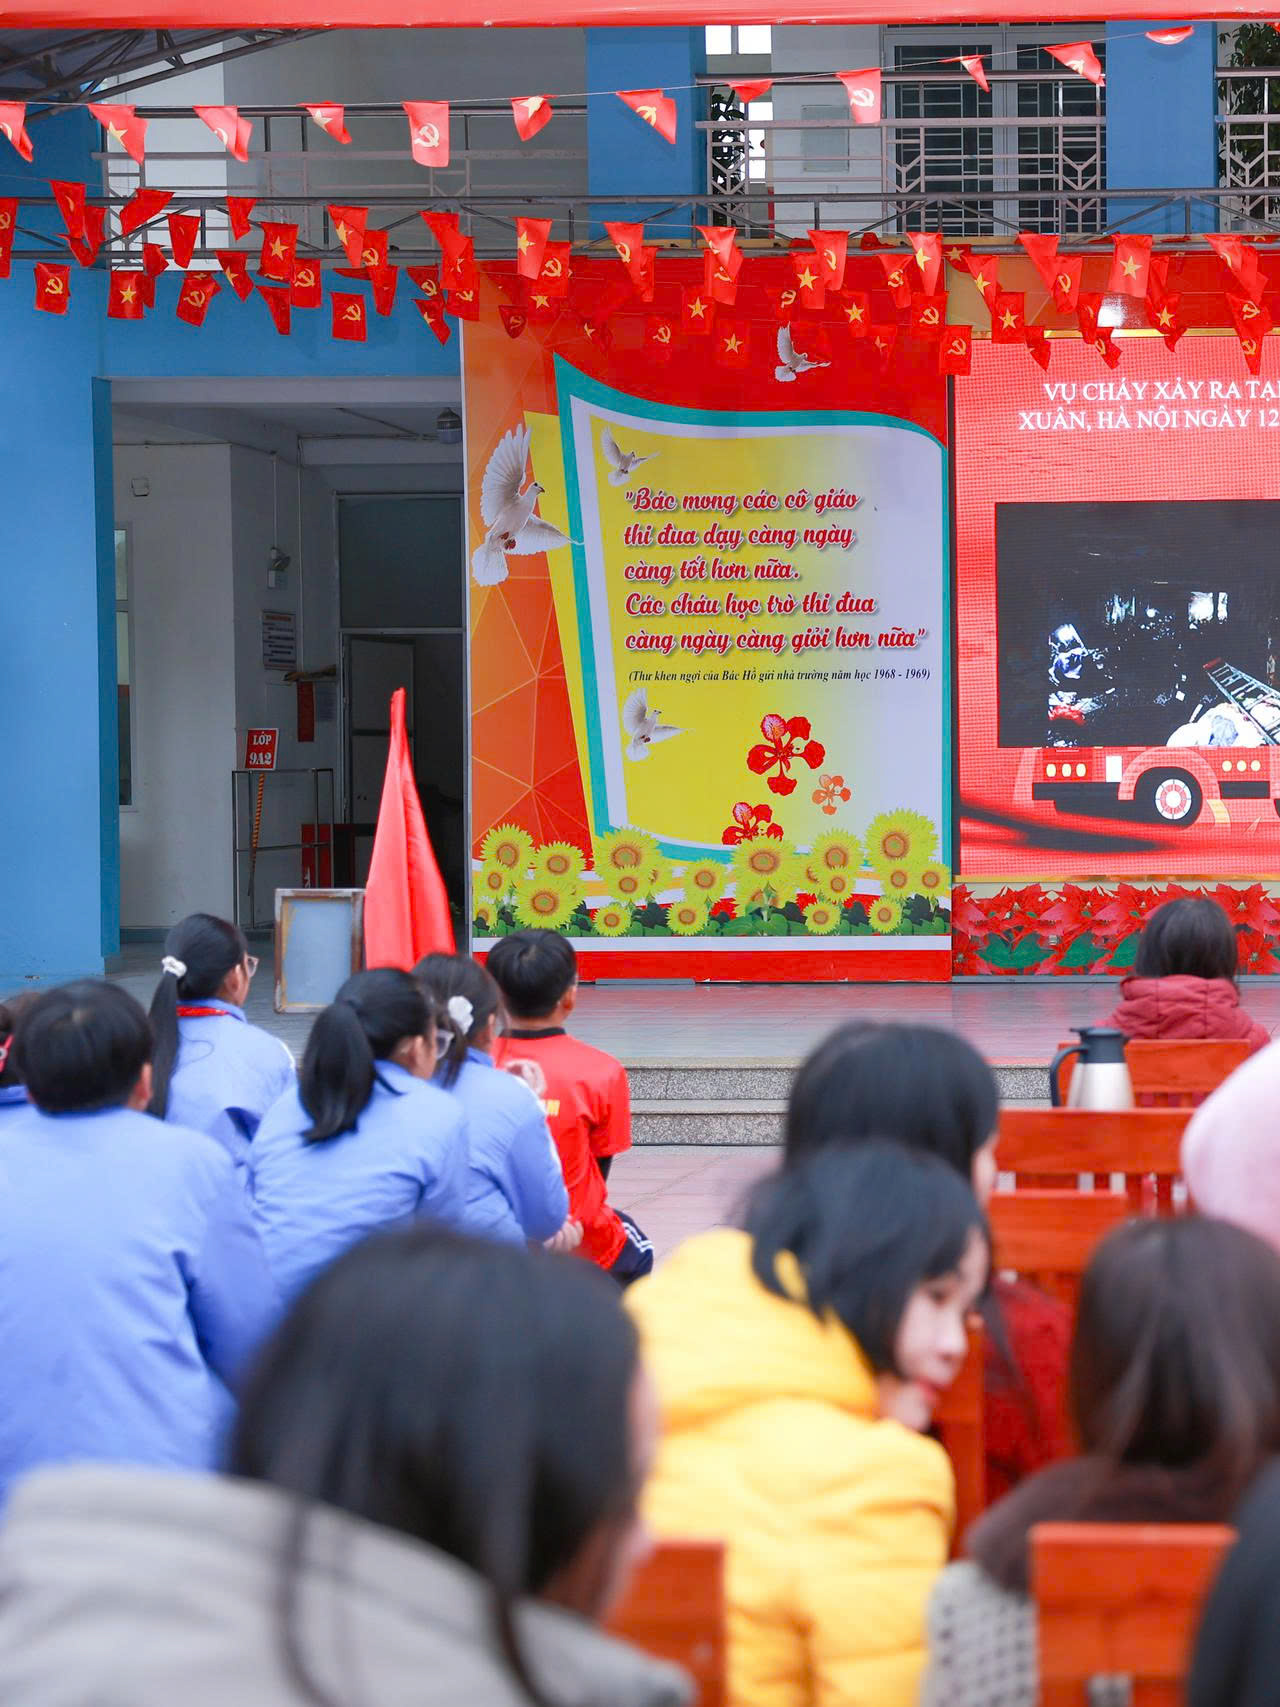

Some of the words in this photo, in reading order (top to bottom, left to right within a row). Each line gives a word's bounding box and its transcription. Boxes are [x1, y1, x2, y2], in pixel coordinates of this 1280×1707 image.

[1044, 383, 1076, 404] VỤ
[1083, 377, 1148, 401] CHÁY
[1153, 376, 1204, 400] XẢY
[1210, 381, 1242, 399] RA
[1018, 406, 1091, 433] XUÂN,
[1098, 406, 1130, 429] HÀ
[1136, 405, 1177, 431] NỘI
[1184, 405, 1251, 429] NGÀY
[682, 495, 737, 515] mong
[743, 489, 778, 509] các
[785, 488, 810, 508] cô
[814, 488, 860, 514] giáo
[624, 523, 652, 545] thi
[657, 523, 697, 545] đua
[703, 523, 742, 550] dạy
[748, 524, 798, 550] càng
[803, 524, 855, 549] ngày
[624, 560, 673, 585] càng
[680, 555, 706, 580] tốt
[711, 558, 748, 580] hơn
[754, 558, 800, 580] nữa.
[625, 593, 664, 615] Các
[671, 592, 720, 614] cháu
[726, 592, 760, 619] học
[767, 593, 797, 614] trò
[802, 592, 830, 613] thi
[836, 591, 876, 613] đua
[625, 630, 675, 655] càng
[681, 630, 731, 655] ngày
[736, 629, 786, 654] càng
[791, 627, 831, 654] giỏi
[836, 626, 872, 648] hơn
[654, 670, 677, 681] khen
[680, 670, 701, 684] ngợi
[703, 670, 719, 681] của
[722, 669, 740, 681] Bác
[742, 666, 757, 681] Hồ
[777, 669, 795, 680] nhà
[797, 669, 829, 682] trường
[831, 670, 852, 680] năm
[854, 669, 872, 682] học
[874, 668, 896, 679] 1968
[905, 668, 931, 680] 1969)
[253, 731, 272, 746] LỚP
[249, 752, 272, 765] 9A2
